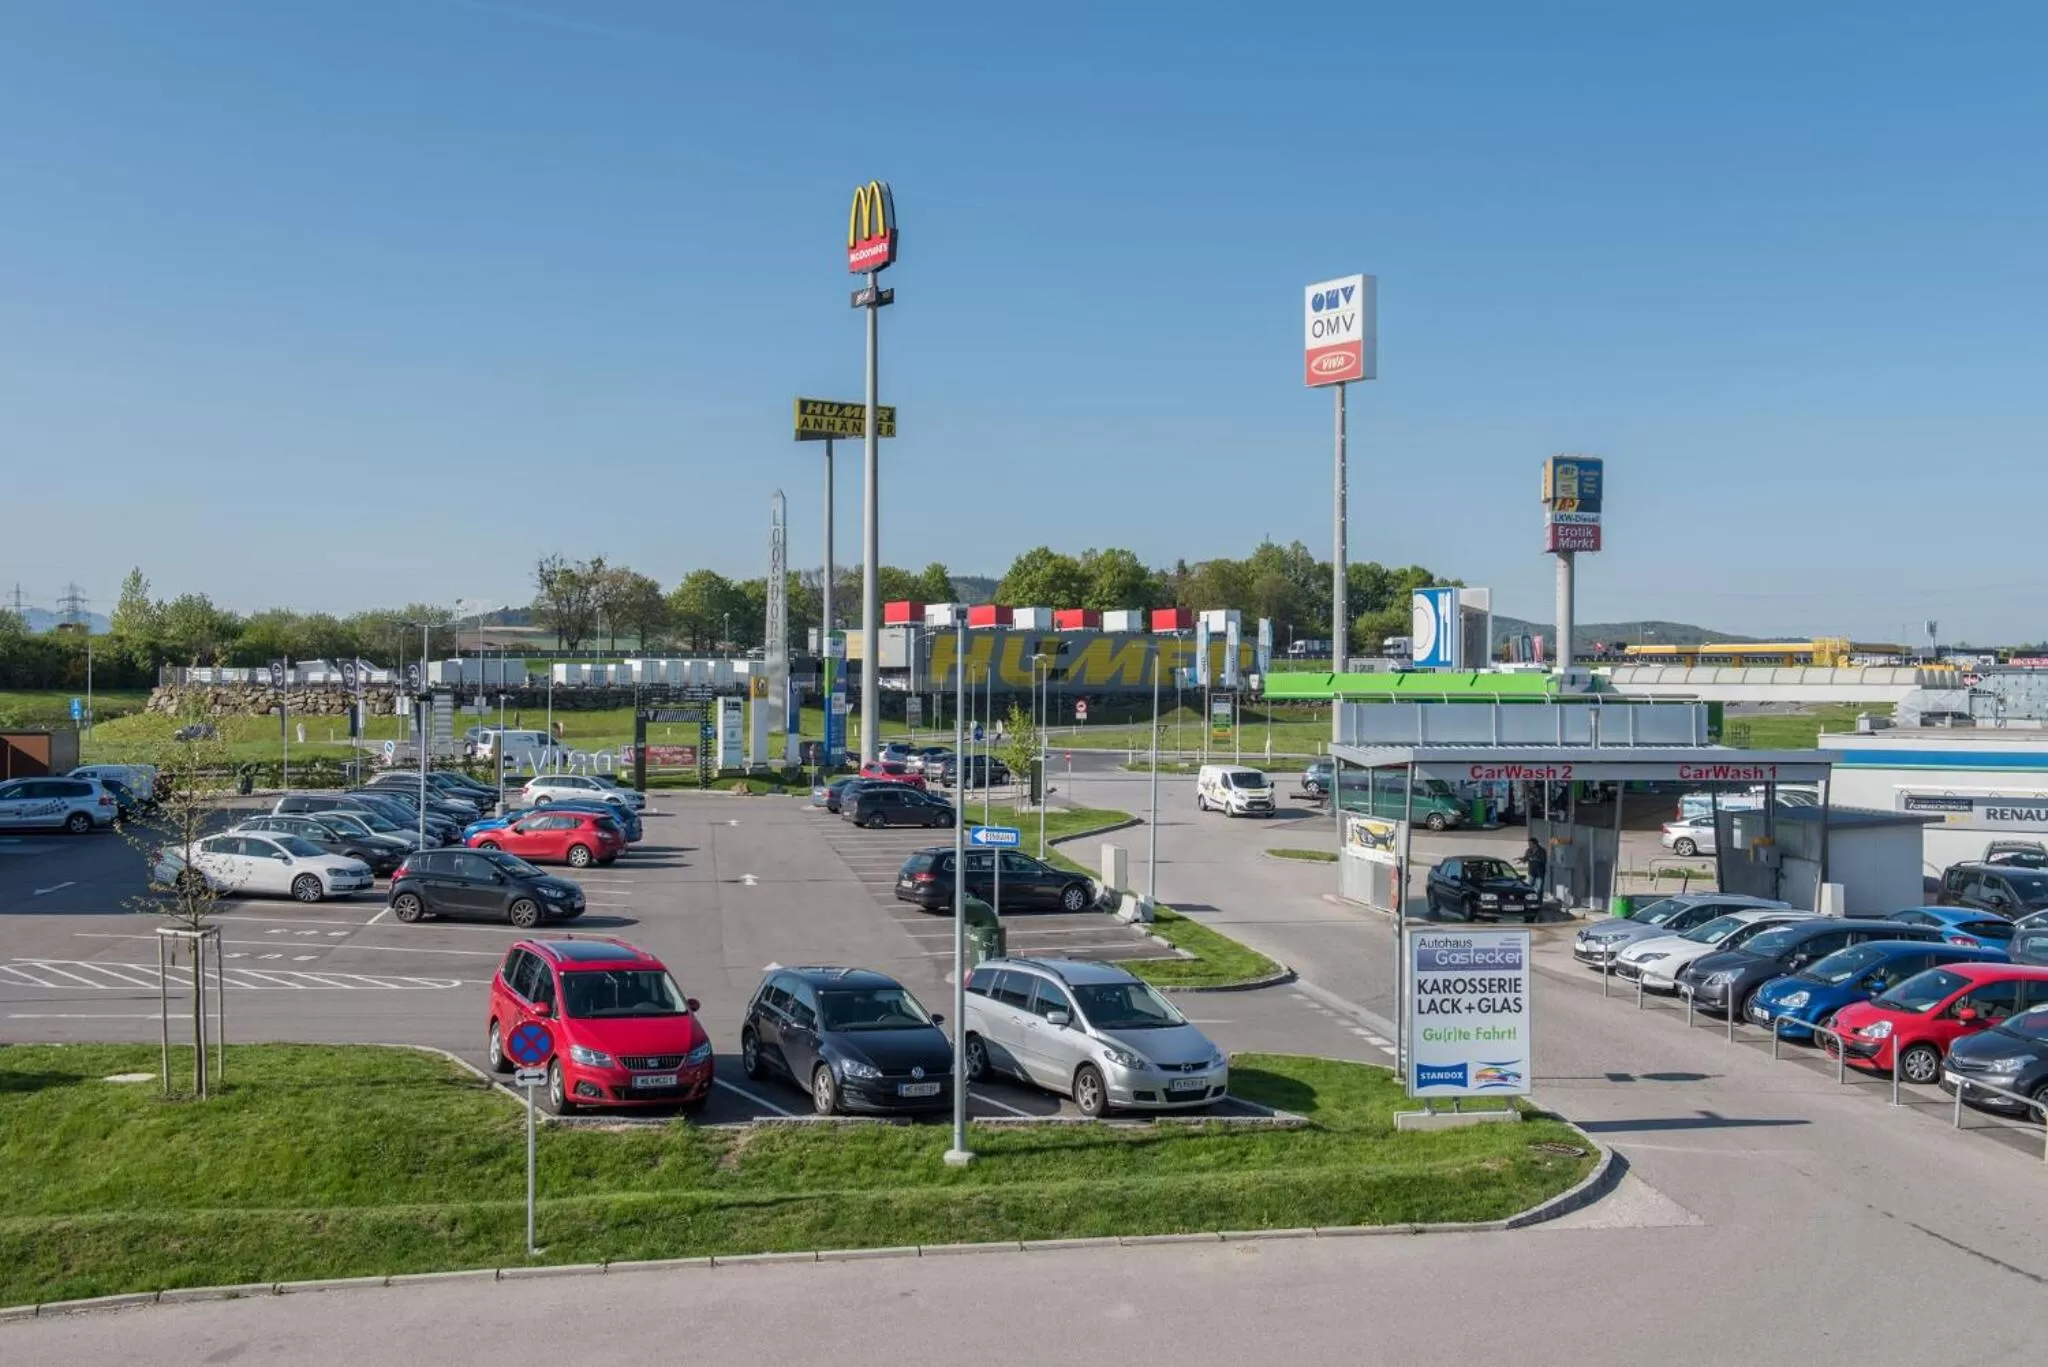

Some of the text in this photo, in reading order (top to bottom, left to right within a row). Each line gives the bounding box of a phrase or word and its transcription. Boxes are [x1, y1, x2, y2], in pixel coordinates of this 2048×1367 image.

[1312, 313, 1355, 338] OMV
[806, 402, 890, 422] HUMR
[801, 417, 895, 436] ANHÄNER
[1558, 526, 1593, 537] Erotik
[1558, 538, 1594, 549] Markt
[1470, 765, 1573, 780] CarWash 2
[1679, 765, 1778, 780] CarWash 1
[1418, 937, 1473, 949] Autohaus
[1417, 977, 1523, 995] KAROSSERIE
[1475, 1026, 1517, 1041] Fahrt!
[1420, 1071, 1464, 1081] STANDOX
